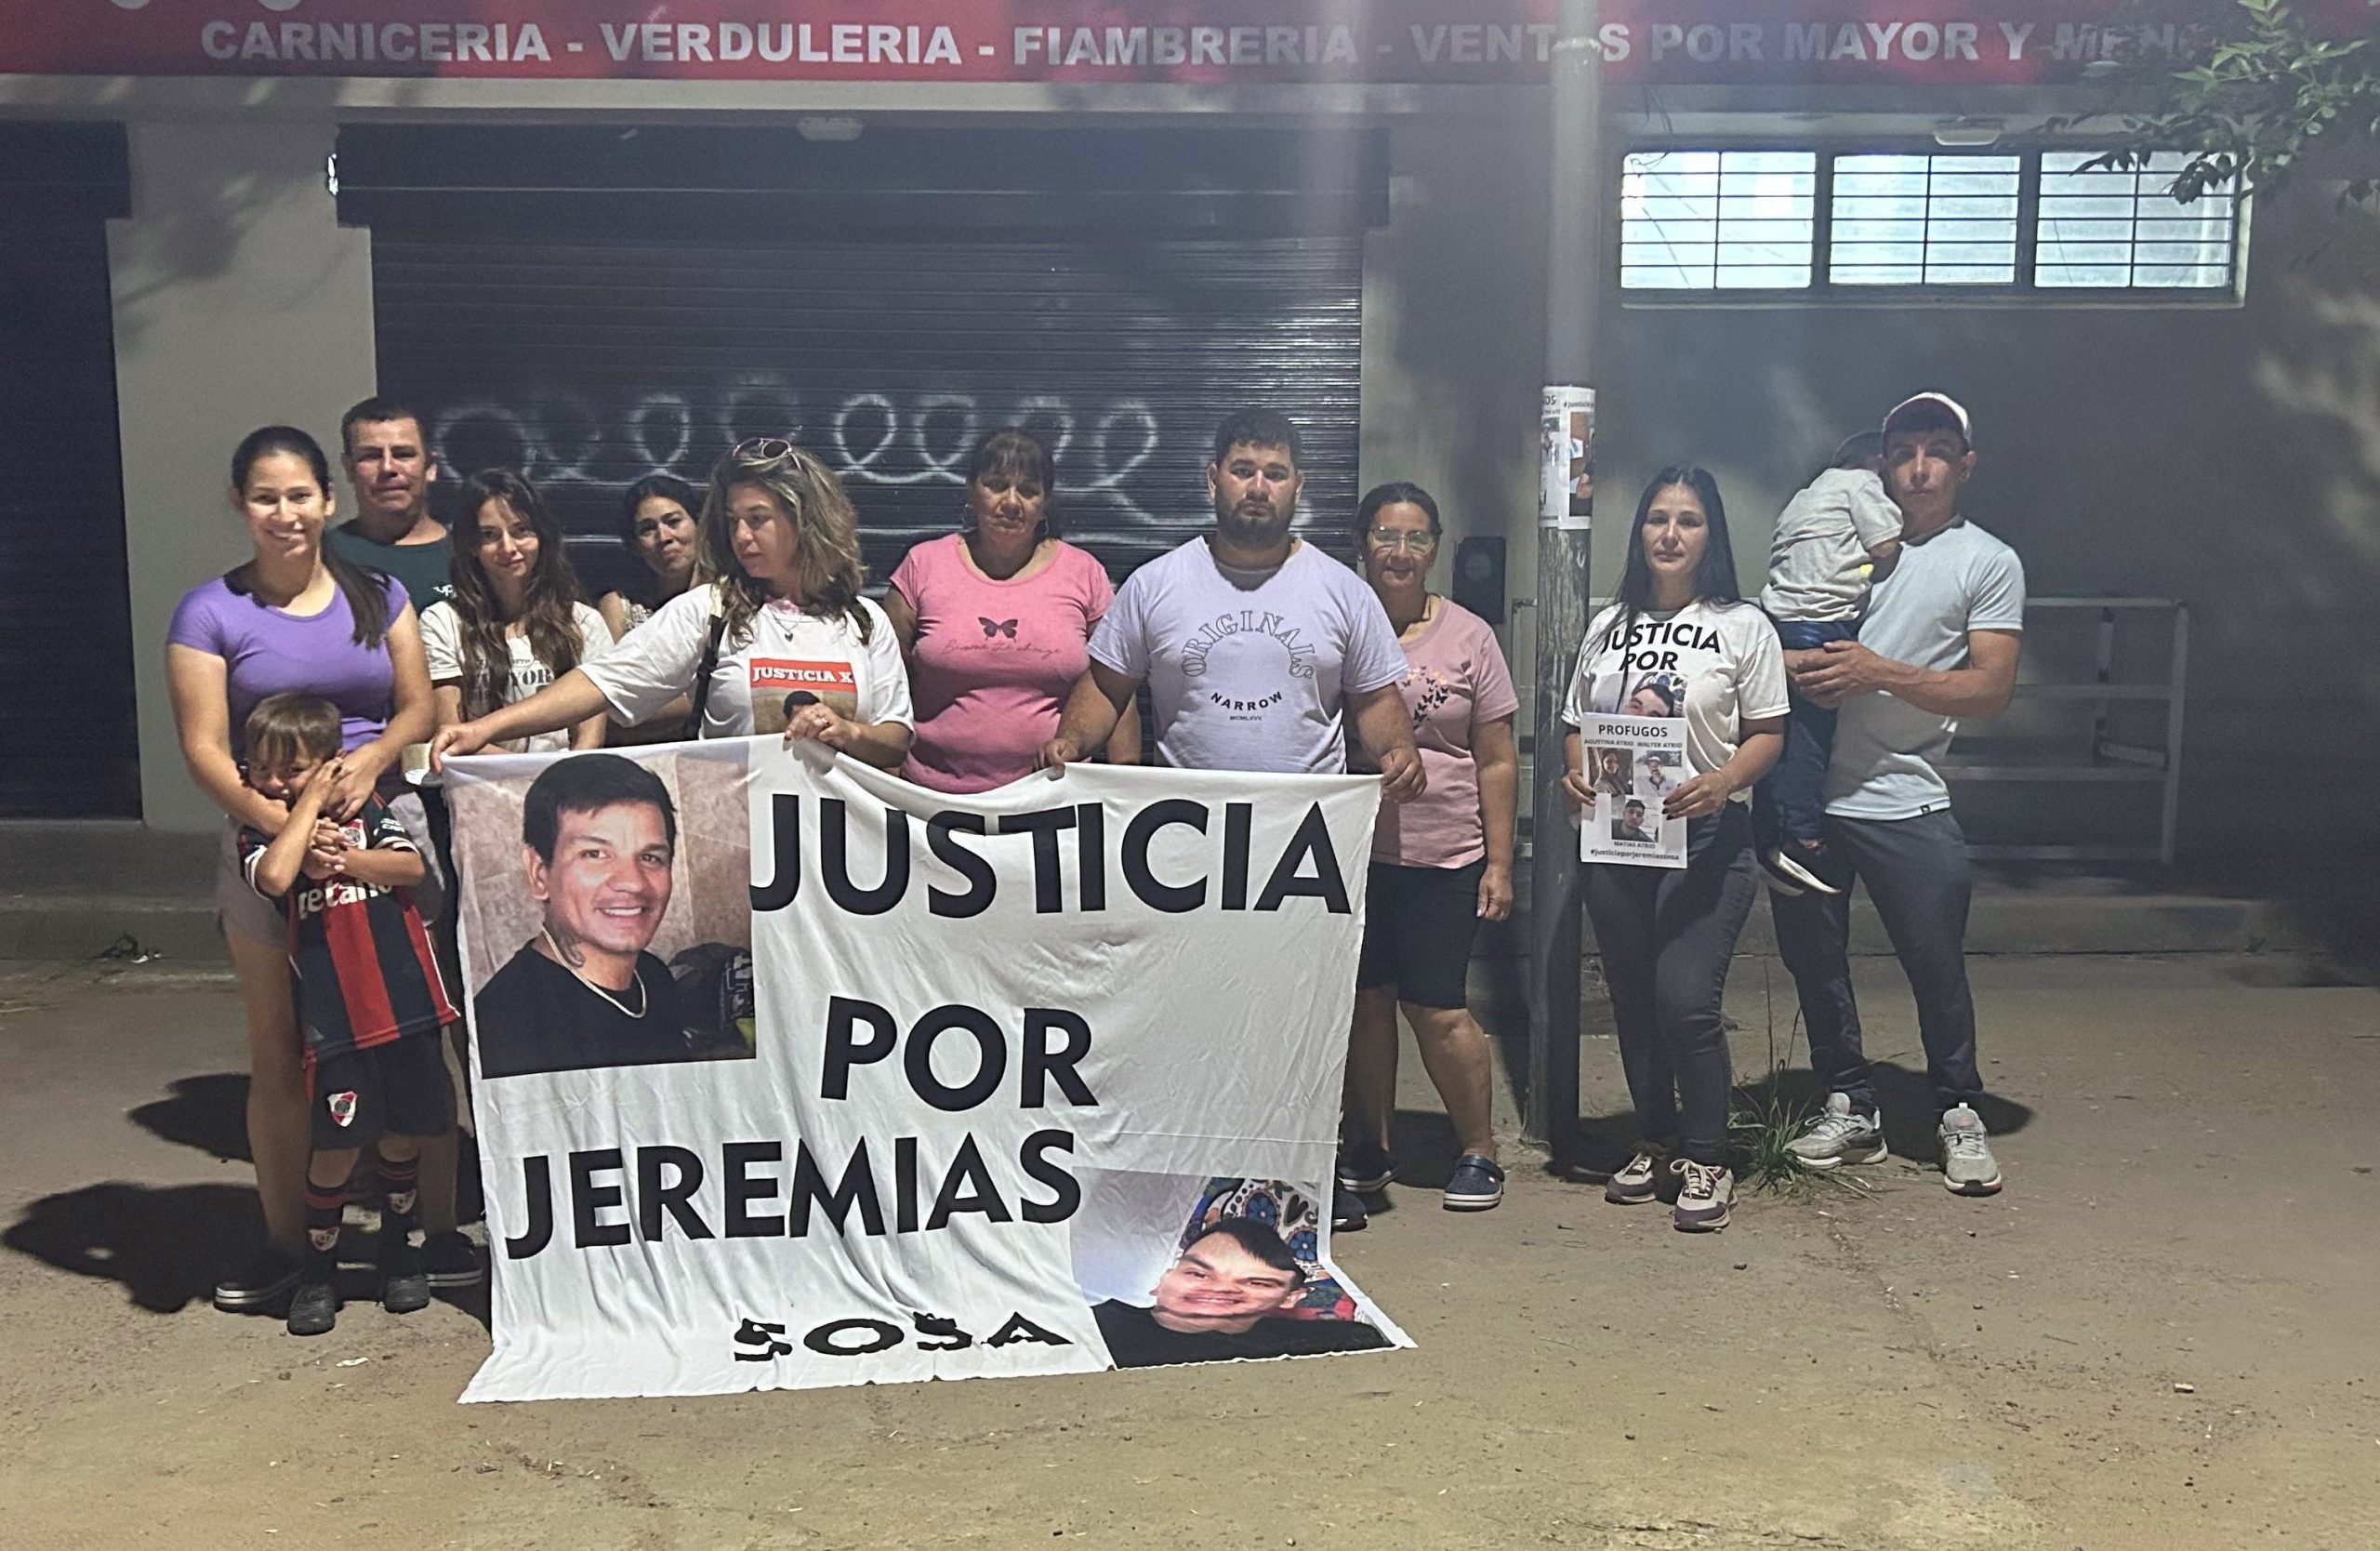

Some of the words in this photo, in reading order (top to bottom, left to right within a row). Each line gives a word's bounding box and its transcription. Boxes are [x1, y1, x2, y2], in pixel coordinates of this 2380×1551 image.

[200, 20, 552, 62] CARNICERIA
[599, 22, 963, 64] VERDULERIA
[1012, 26, 1360, 65] FIAMBRERIA
[1408, 22, 1632, 62] VENTS
[1650, 22, 1765, 61] POR
[1782, 22, 1980, 61] MAYOR
[1997, 21, 2038, 60] Y
[1181, 610, 1316, 680] ORIGINALS
[1600, 622, 1721, 655] JUSTICIA
[1618, 650, 1679, 671] POR
[752, 667, 837, 683] JUSTICIA
[838, 670, 854, 683] X
[1210, 691, 1282, 711] NARROW
[1598, 724, 1668, 736] PROFUGOS
[749, 794, 1352, 917] JUSTICIA
[819, 995, 1099, 1112] POR
[505, 1128, 1082, 1260] JEREMIAS
[732, 1310, 1076, 1362] SOSA
